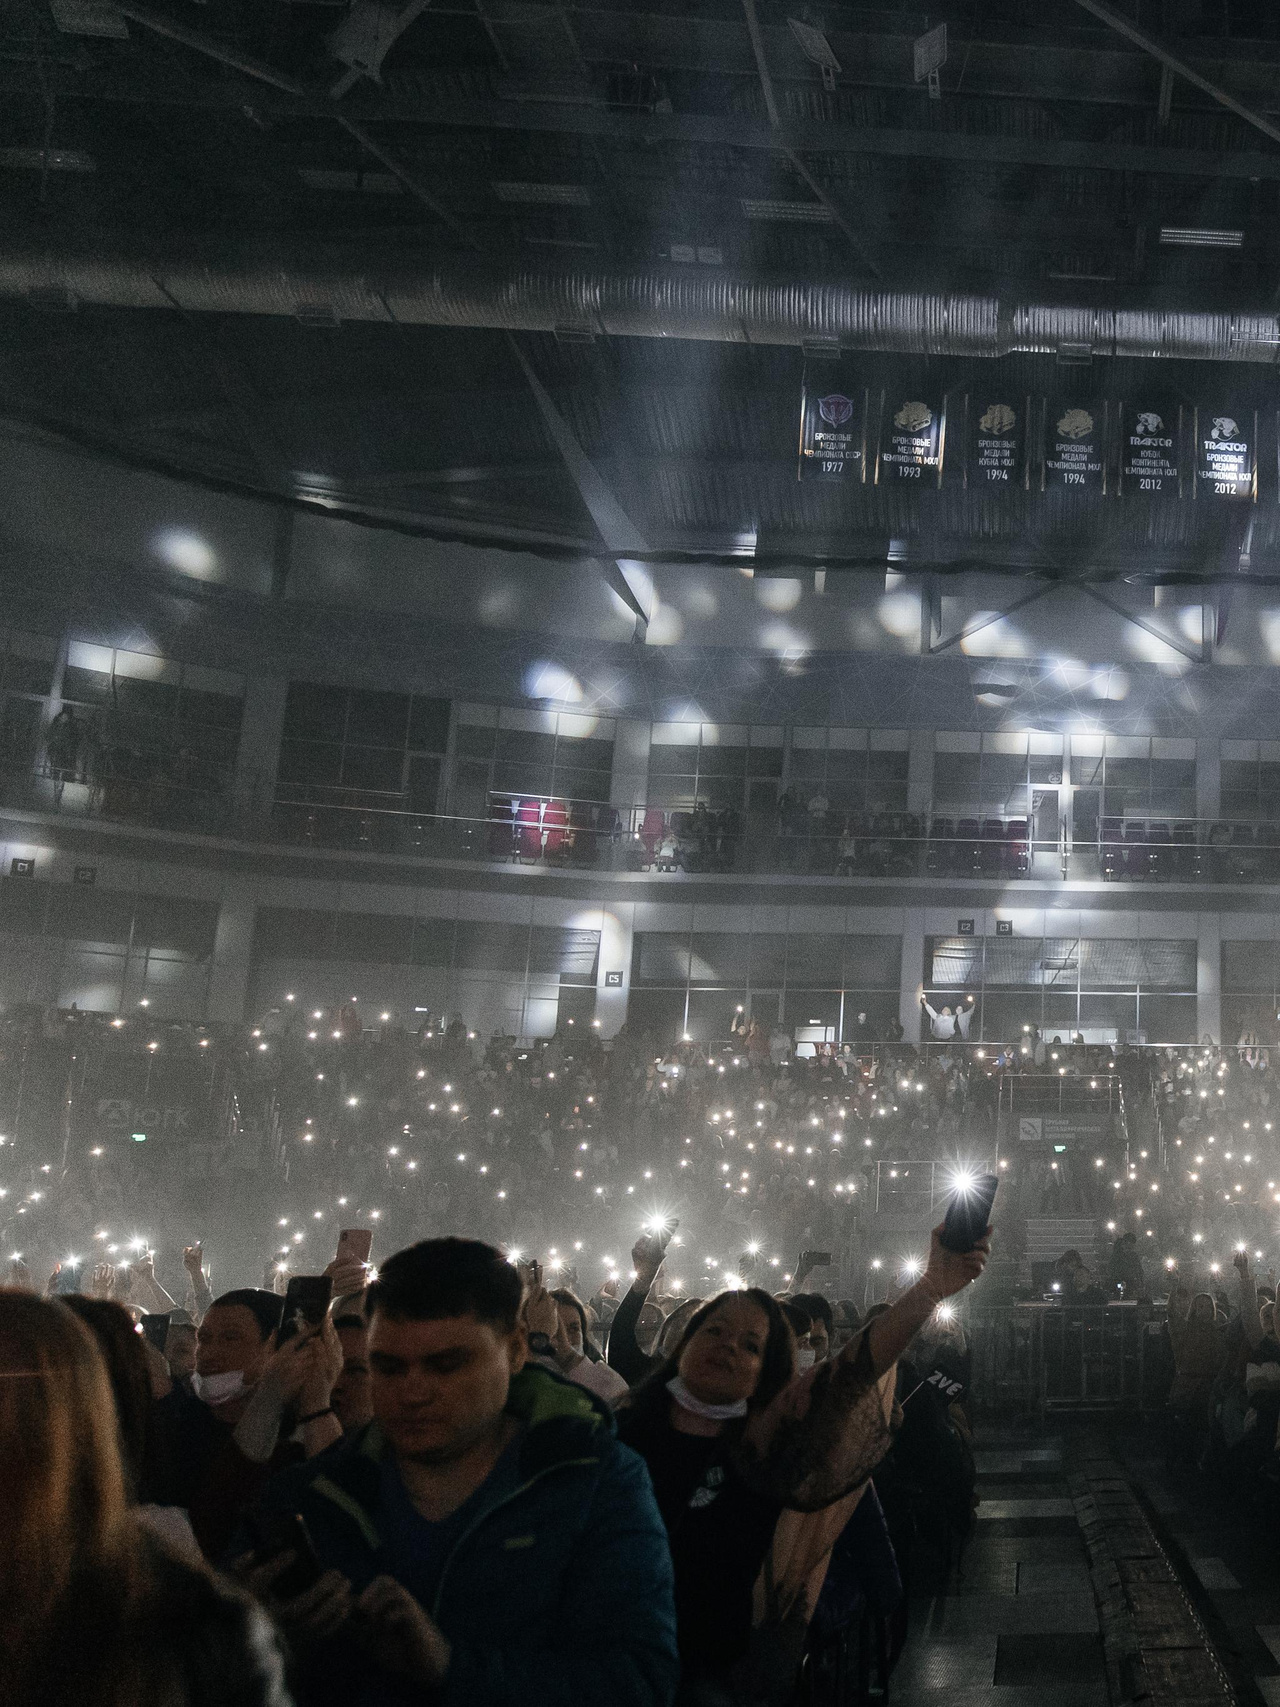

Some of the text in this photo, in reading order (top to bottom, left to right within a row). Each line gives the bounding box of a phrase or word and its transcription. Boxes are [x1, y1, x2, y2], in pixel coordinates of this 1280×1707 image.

[815, 432, 853, 442] БРОНЗОВЫЕ
[892, 436, 931, 447] БРОНЗОВЫЕ
[1129, 436, 1173, 447] TRAKTOR
[978, 439, 1017, 449] БРОНЗОВЫЕ
[1055, 443, 1094, 453] БРОНЗОВЫЕ
[1204, 440, 1248, 452] TRAKTOR
[1061, 452, 1087, 462] МЕДАЛИ
[1206, 453, 1244, 463] БРОНЗОВЫЕ
[822, 461, 843, 472] 1977
[1046, 460, 1086, 471] ЧЕМПИОНАТА
[1212, 462, 1238, 472] МЕДАЛИ
[899, 466, 921, 478] 1993
[986, 469, 1008, 480] 1994
[1063, 472, 1085, 484] 1994
[1140, 478, 1162, 490] 2012
[1214, 482, 1237, 495] 2012
